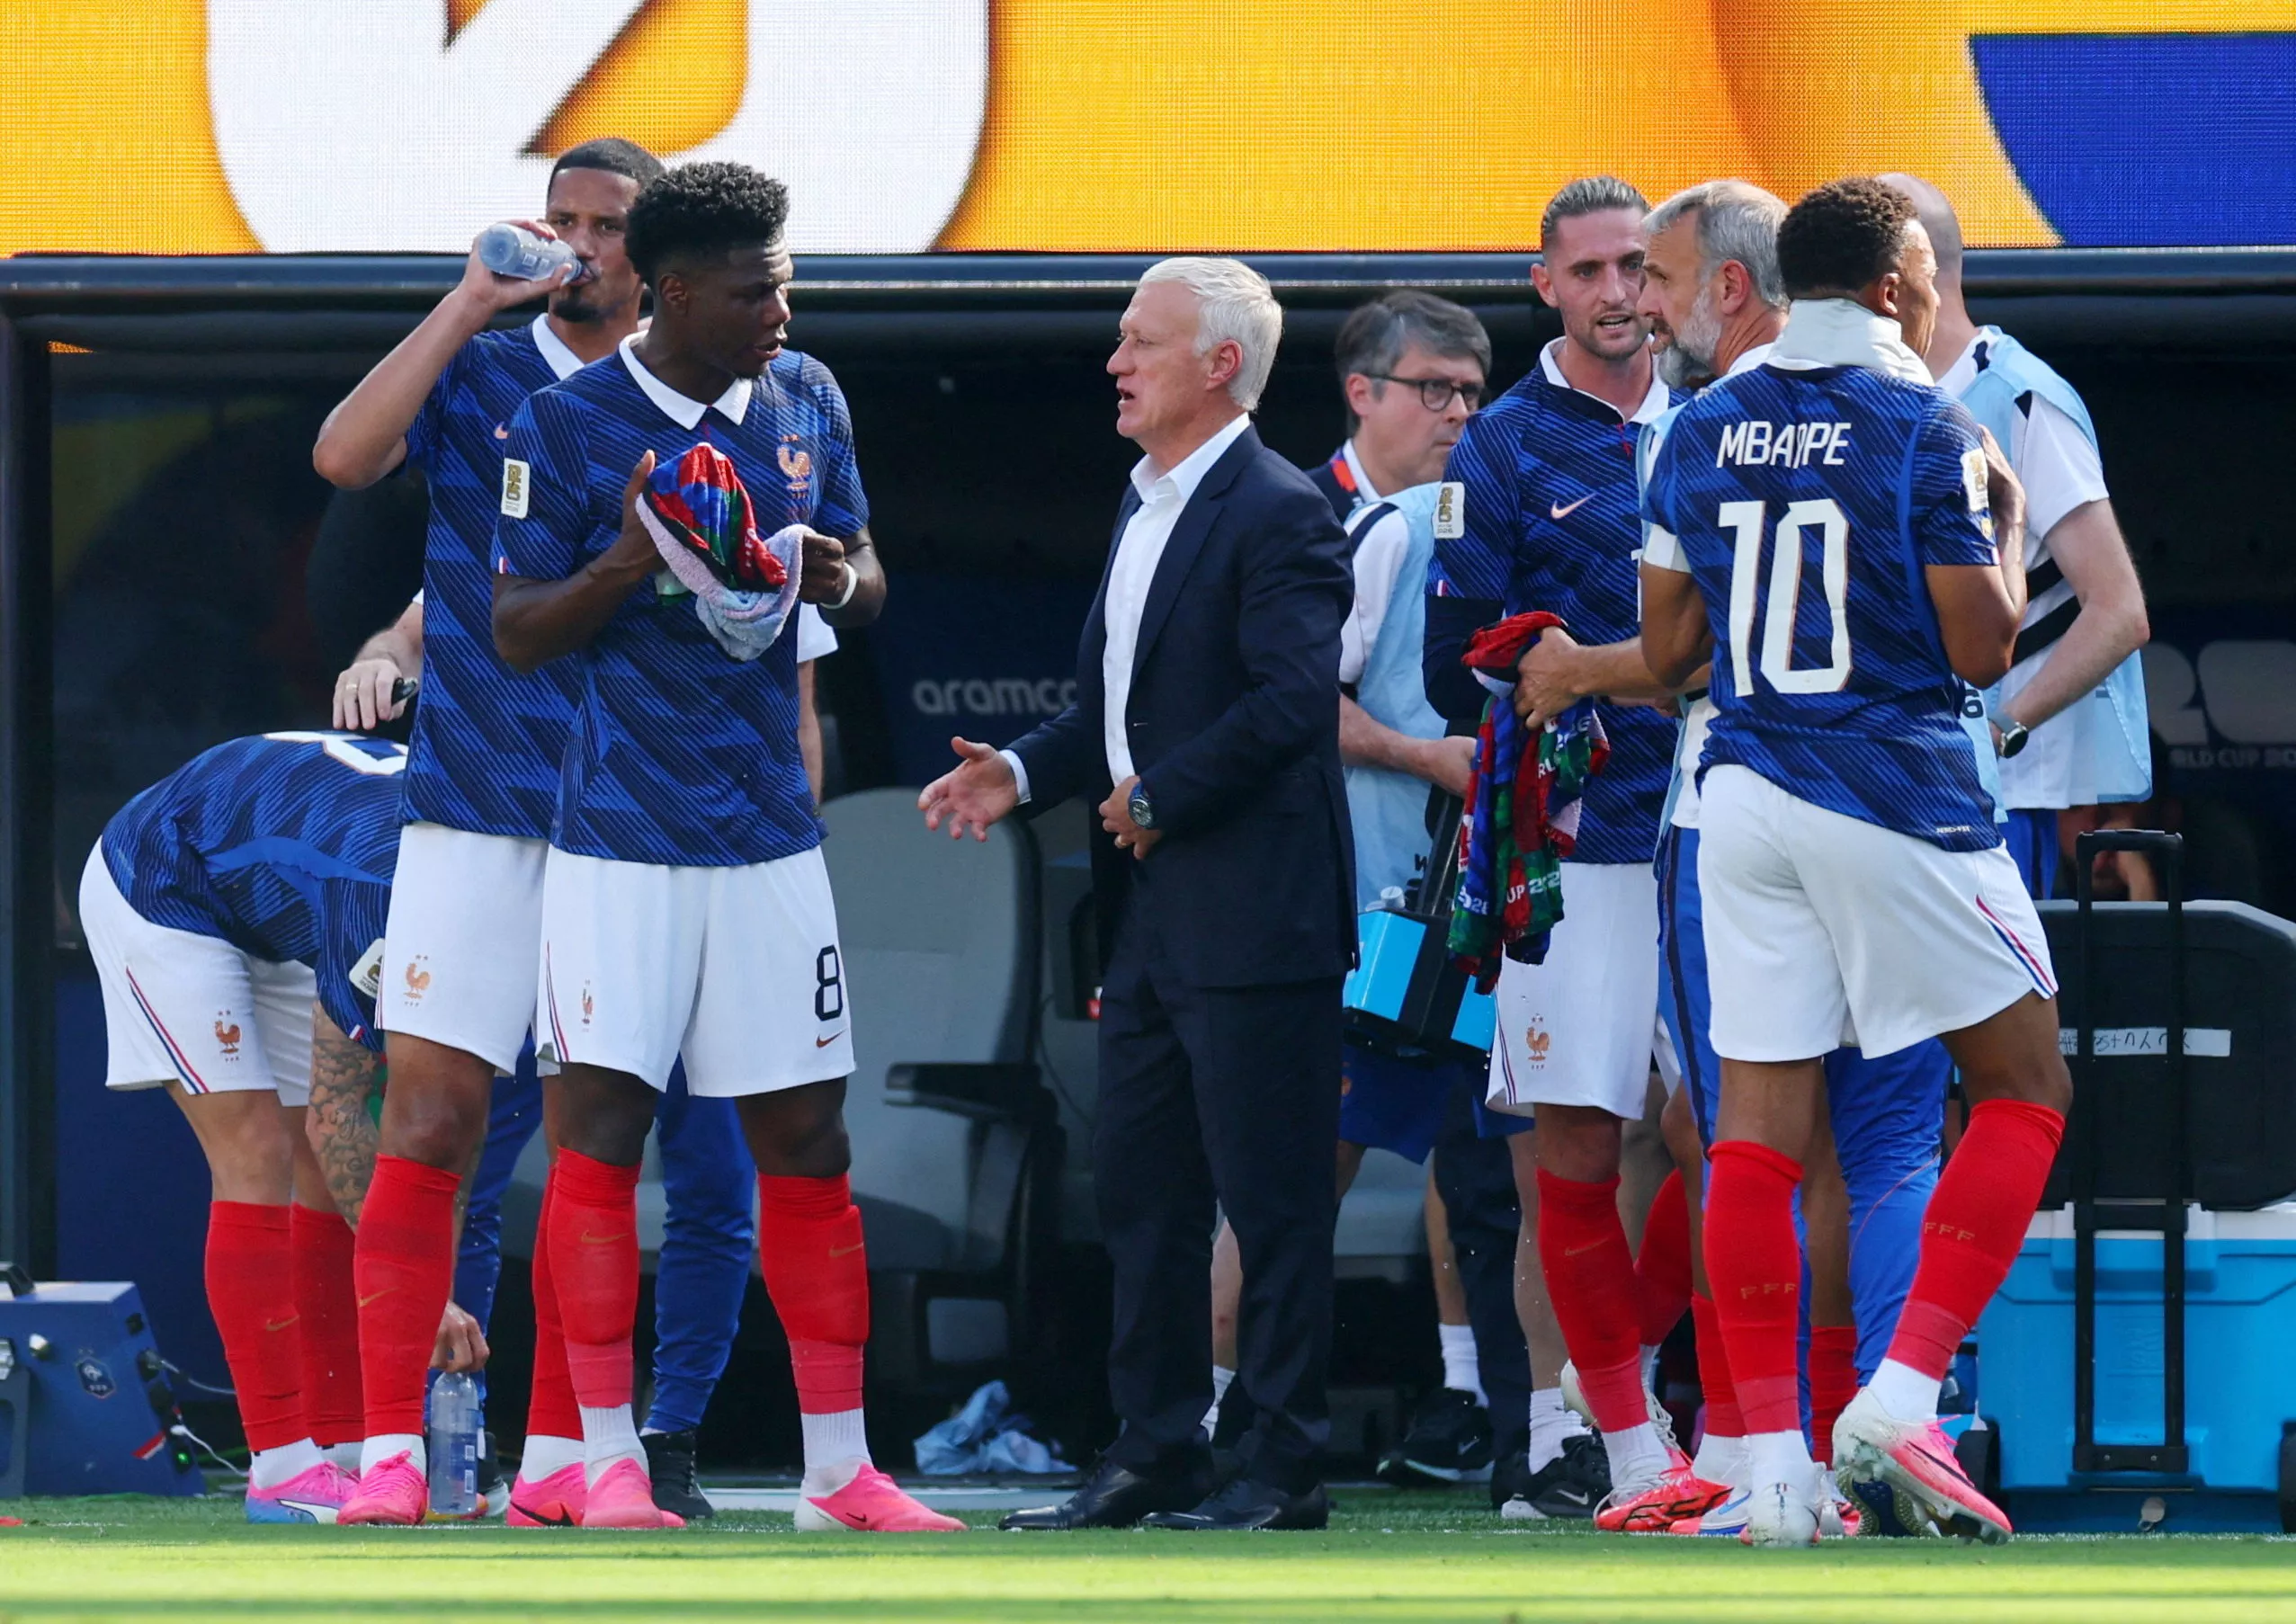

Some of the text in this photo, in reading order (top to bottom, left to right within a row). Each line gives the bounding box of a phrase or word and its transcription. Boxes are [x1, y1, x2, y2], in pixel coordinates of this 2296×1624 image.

[1718, 498, 1854, 698] 10
[815, 944, 844, 1022] 8
[1924, 1222, 1976, 1242] FFF
[1741, 1283, 1798, 1300] FFF
